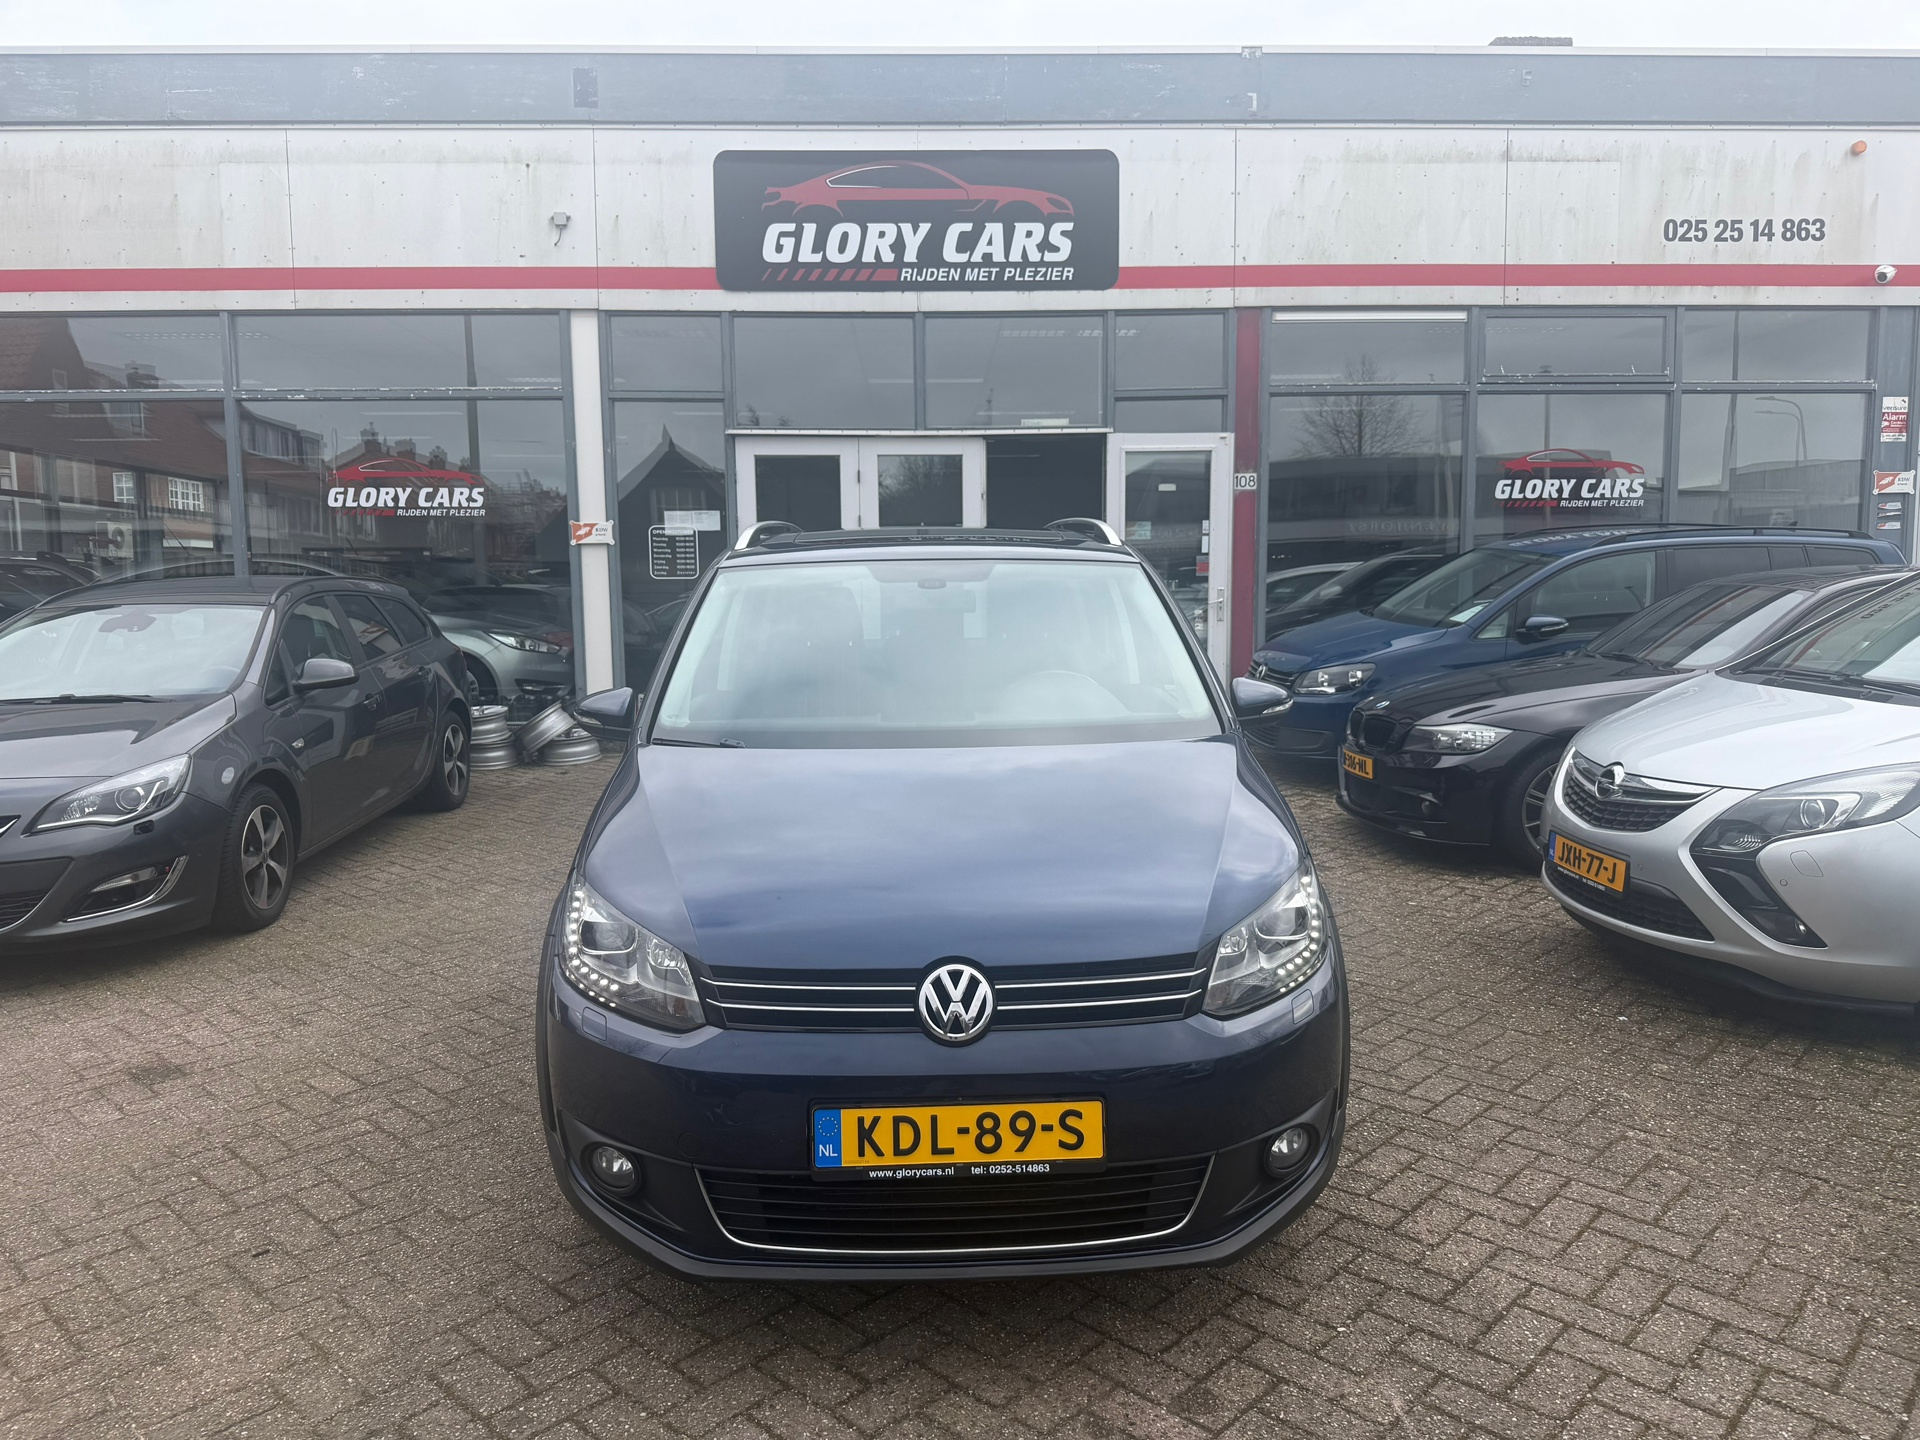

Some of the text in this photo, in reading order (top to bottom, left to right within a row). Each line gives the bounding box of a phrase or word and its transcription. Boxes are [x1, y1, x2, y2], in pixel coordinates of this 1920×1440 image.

[1663, 218, 1826, 243] 025 25 14 863
[761, 222, 1075, 264] GLORY CARS
[900, 267, 1075, 282] RIJDEN MET PLEZIER
[1882, 412, 1907, 421] Alarm
[1235, 475, 1256, 488] 108
[1494, 478, 1645, 499] GLORY CARS
[327, 487, 485, 507] GLORY CARS
[396, 509, 428, 517] RIJDEN
[1558, 841, 1617, 884] JXH-77-J
[818, 1108, 1085, 1158] NL KDL-89-S
[869, 1163, 1050, 1179] www.glorycars.nl tel: 0252-514863
